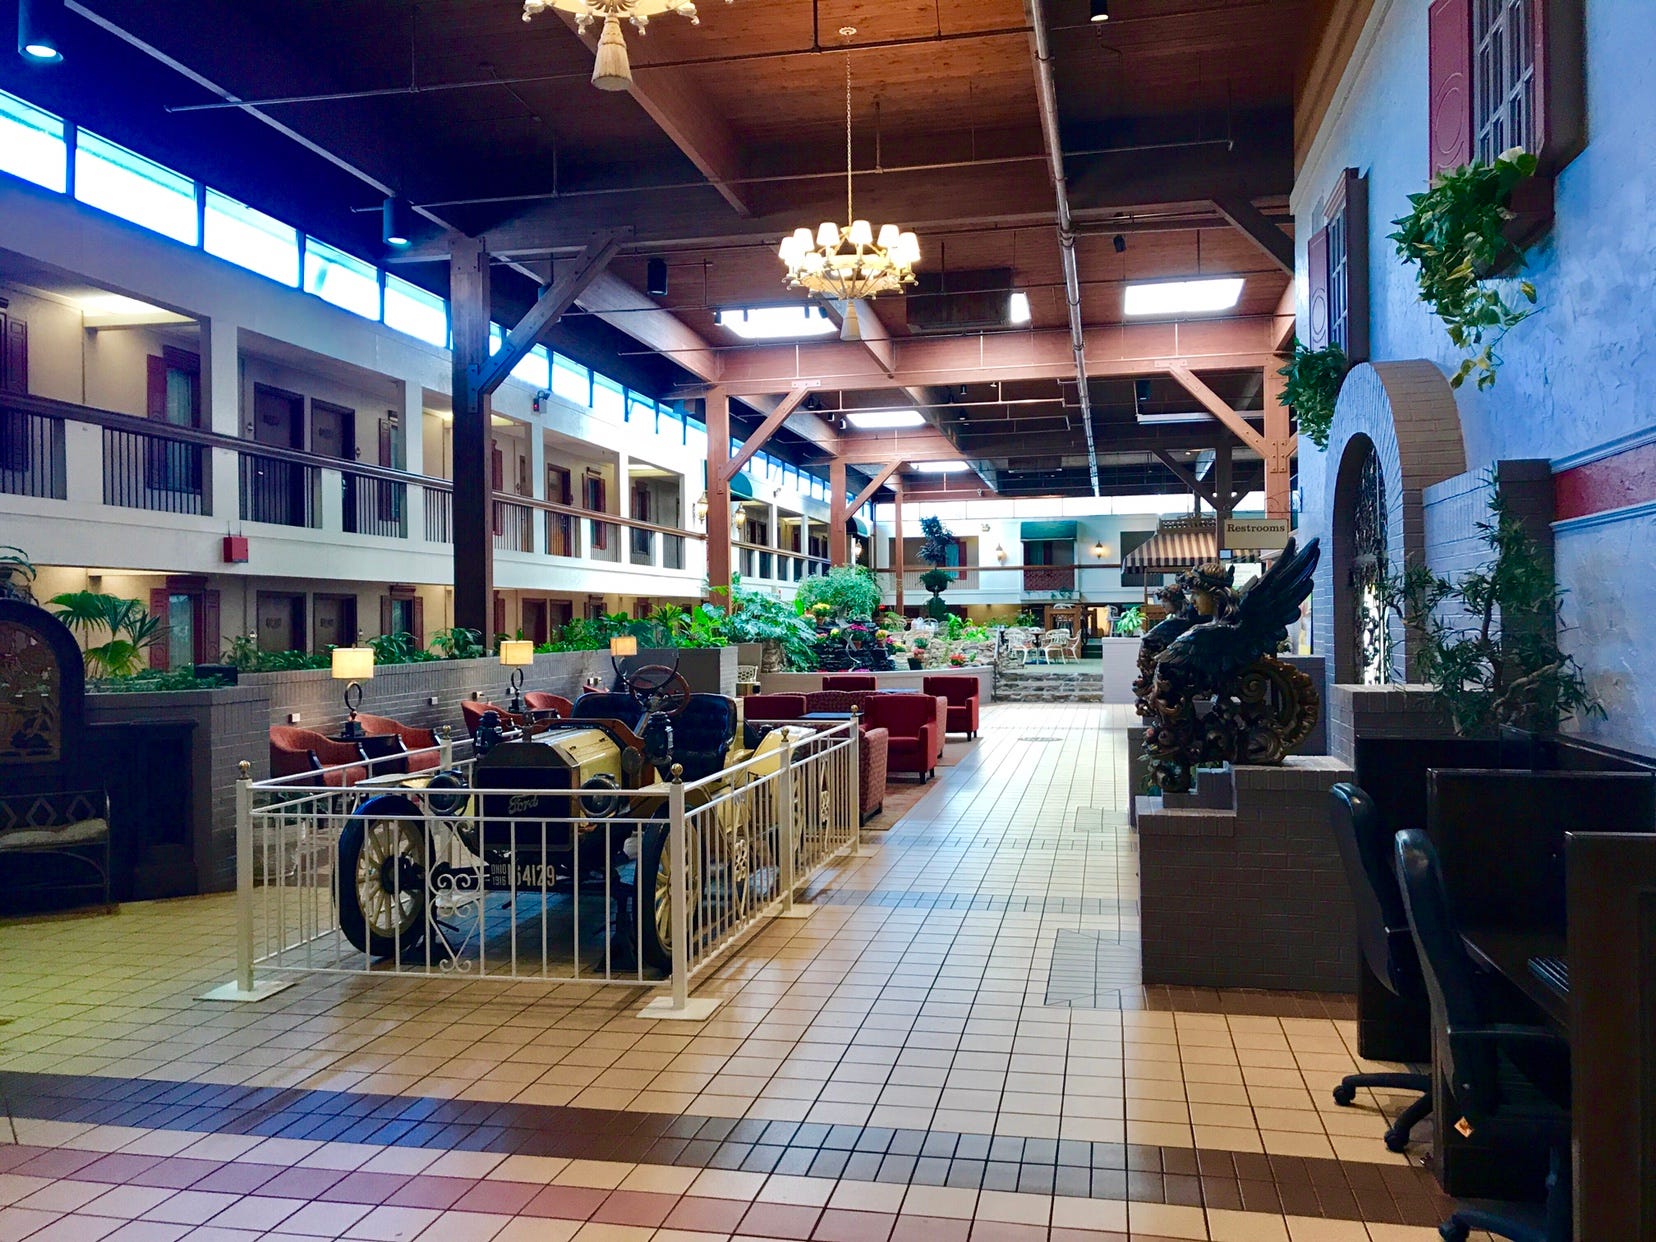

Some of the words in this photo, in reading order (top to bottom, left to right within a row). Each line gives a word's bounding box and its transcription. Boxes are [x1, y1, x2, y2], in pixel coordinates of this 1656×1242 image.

[1227, 523, 1286, 533] Restrooms
[508, 794, 539, 815] Ford
[490, 863, 507, 875] OHIO
